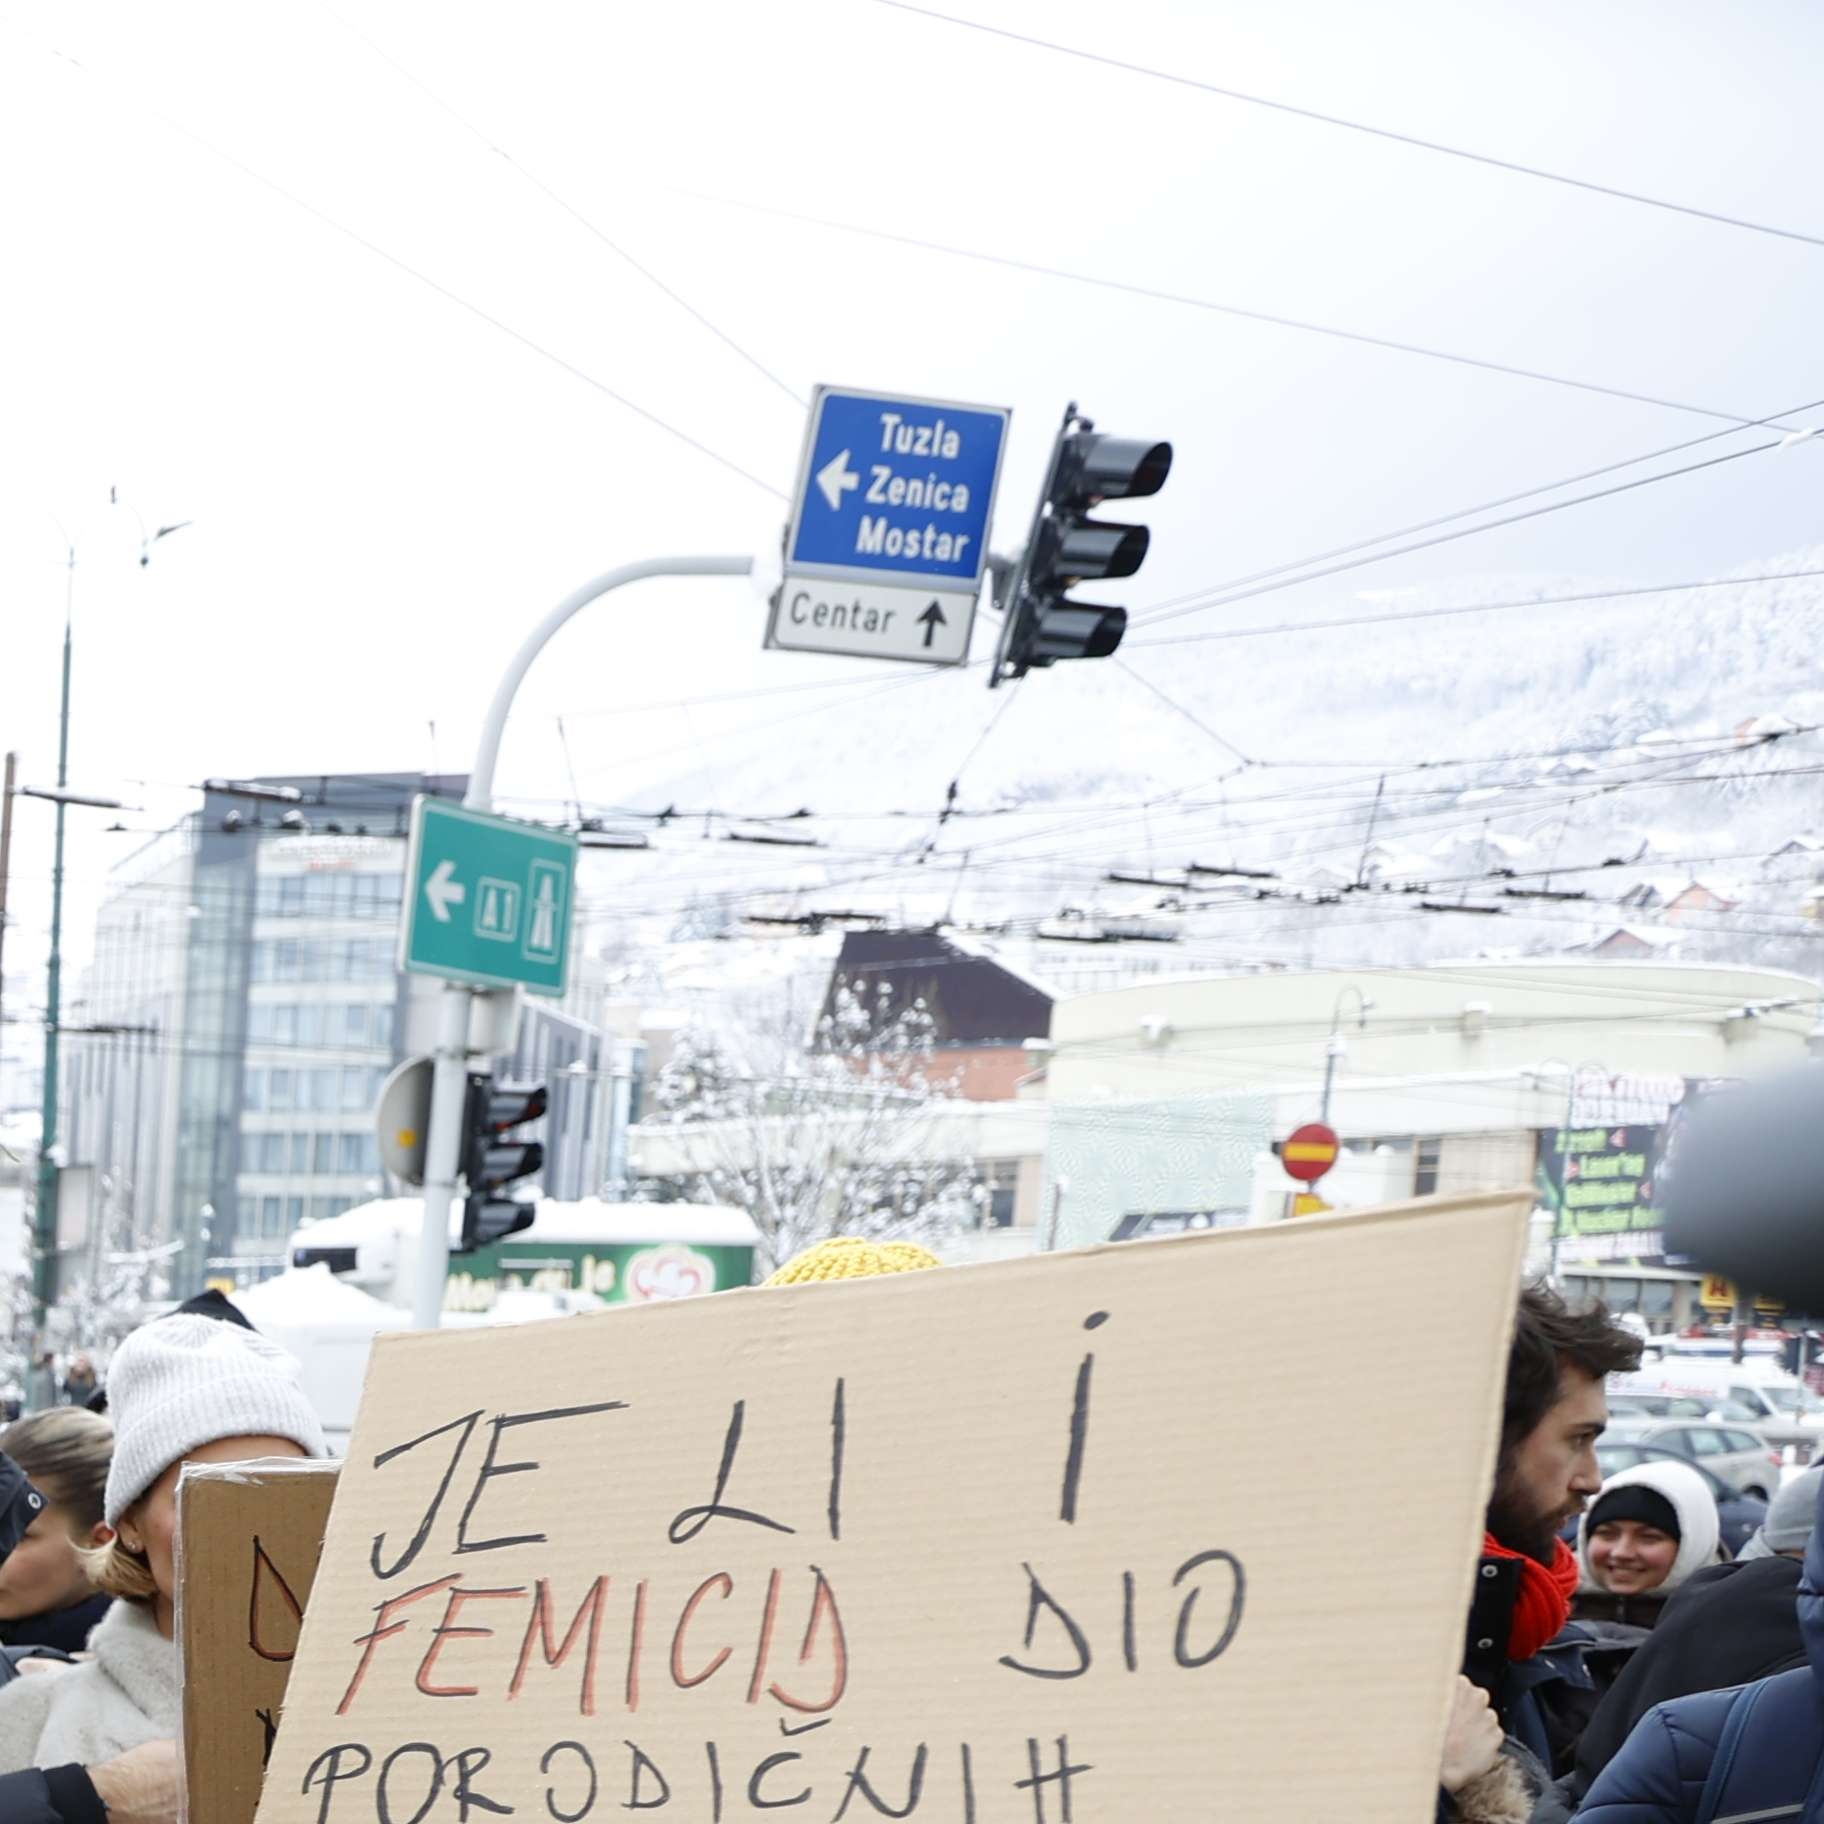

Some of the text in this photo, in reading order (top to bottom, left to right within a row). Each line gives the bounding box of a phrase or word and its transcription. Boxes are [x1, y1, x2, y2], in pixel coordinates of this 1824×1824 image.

[880, 412, 961, 460] Tuzla
[865, 464, 971, 514] Zenica
[855, 514, 971, 564] Mostar
[789, 592, 897, 634] Centar
[481, 885, 513, 932] A1
[370, 1400, 631, 1581] JE
[668, 1376, 845, 1545] LI
[334, 1564, 849, 1717] FEMICID
[998, 1548, 1247, 1680] DIO
